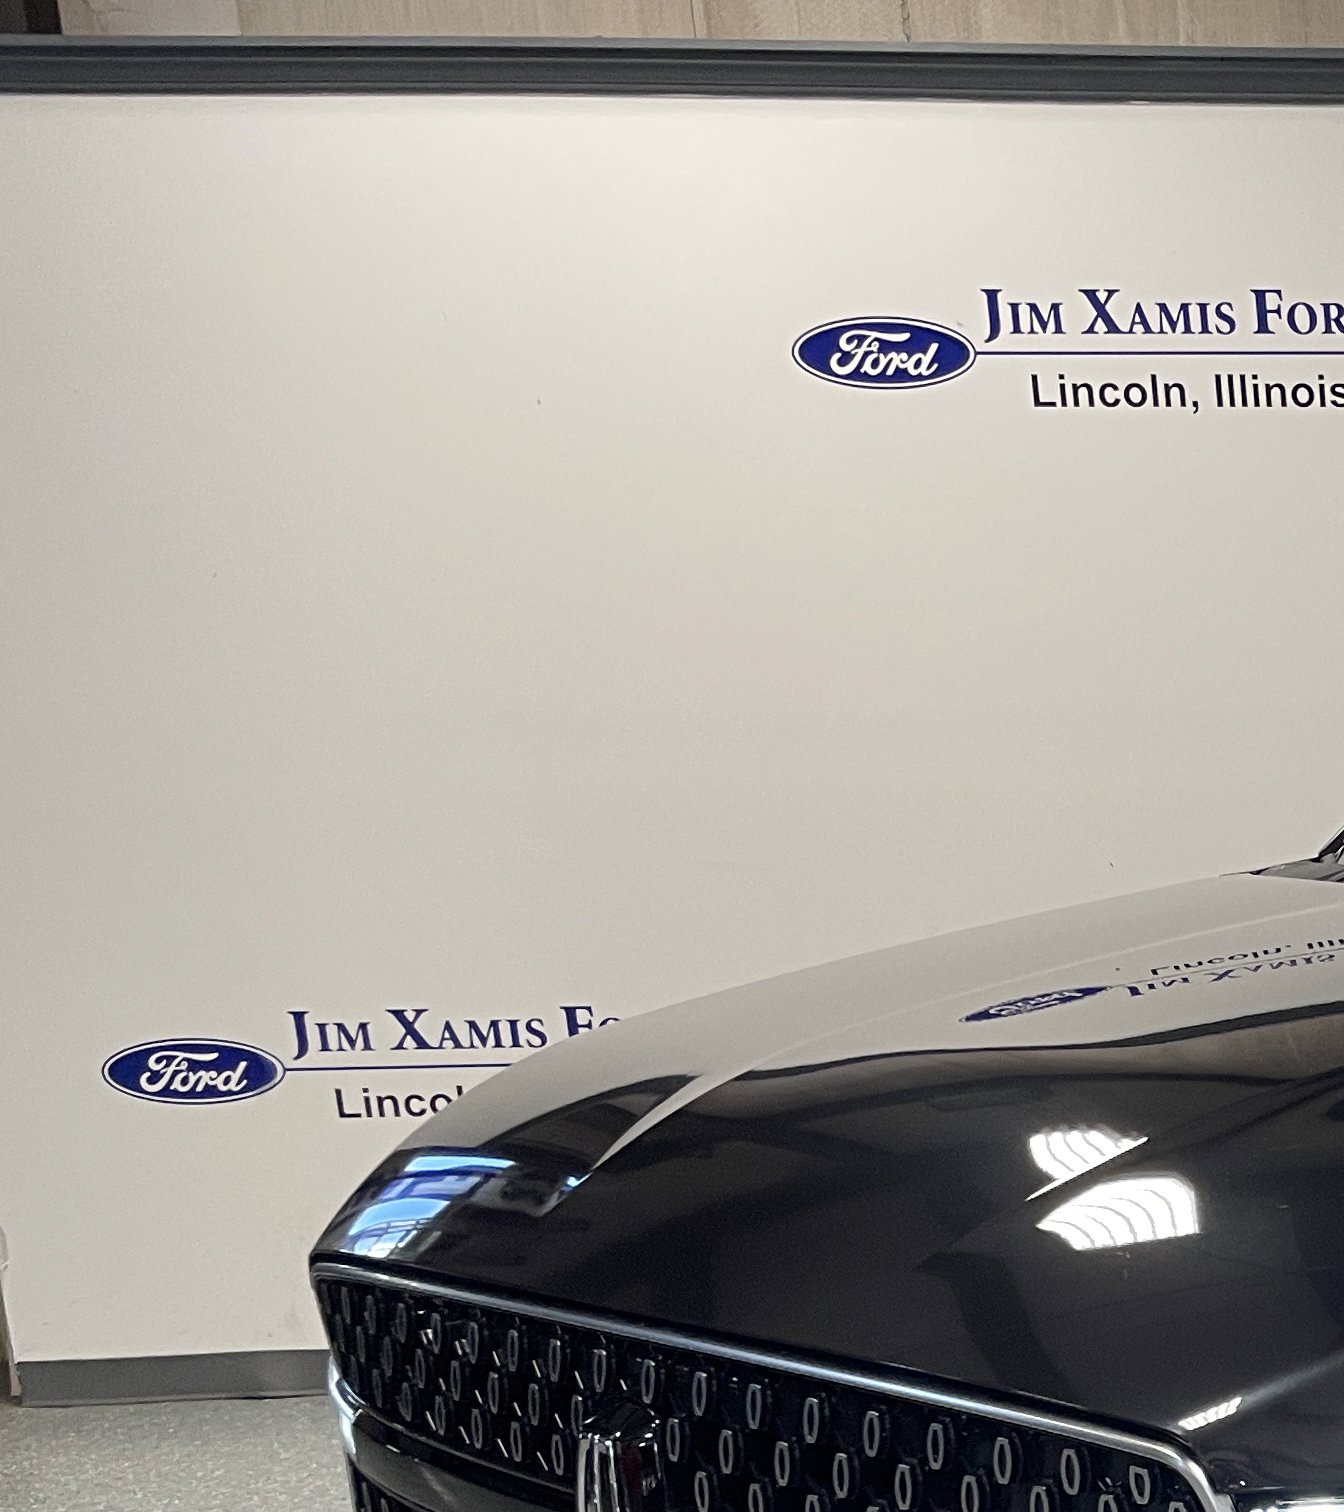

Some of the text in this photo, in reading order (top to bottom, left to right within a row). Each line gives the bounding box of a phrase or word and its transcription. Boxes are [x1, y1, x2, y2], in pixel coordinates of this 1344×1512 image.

[980, 288, 1064, 344] JIM
[1078, 288, 1237, 337] XAMIS
[830, 329, 940, 377] Ford
[1029, 373, 1200, 415] Lincoln,
[286, 1010, 376, 1060] JIM
[385, 1008, 549, 1052] XAMIS
[139, 1051, 248, 1093] Ford
